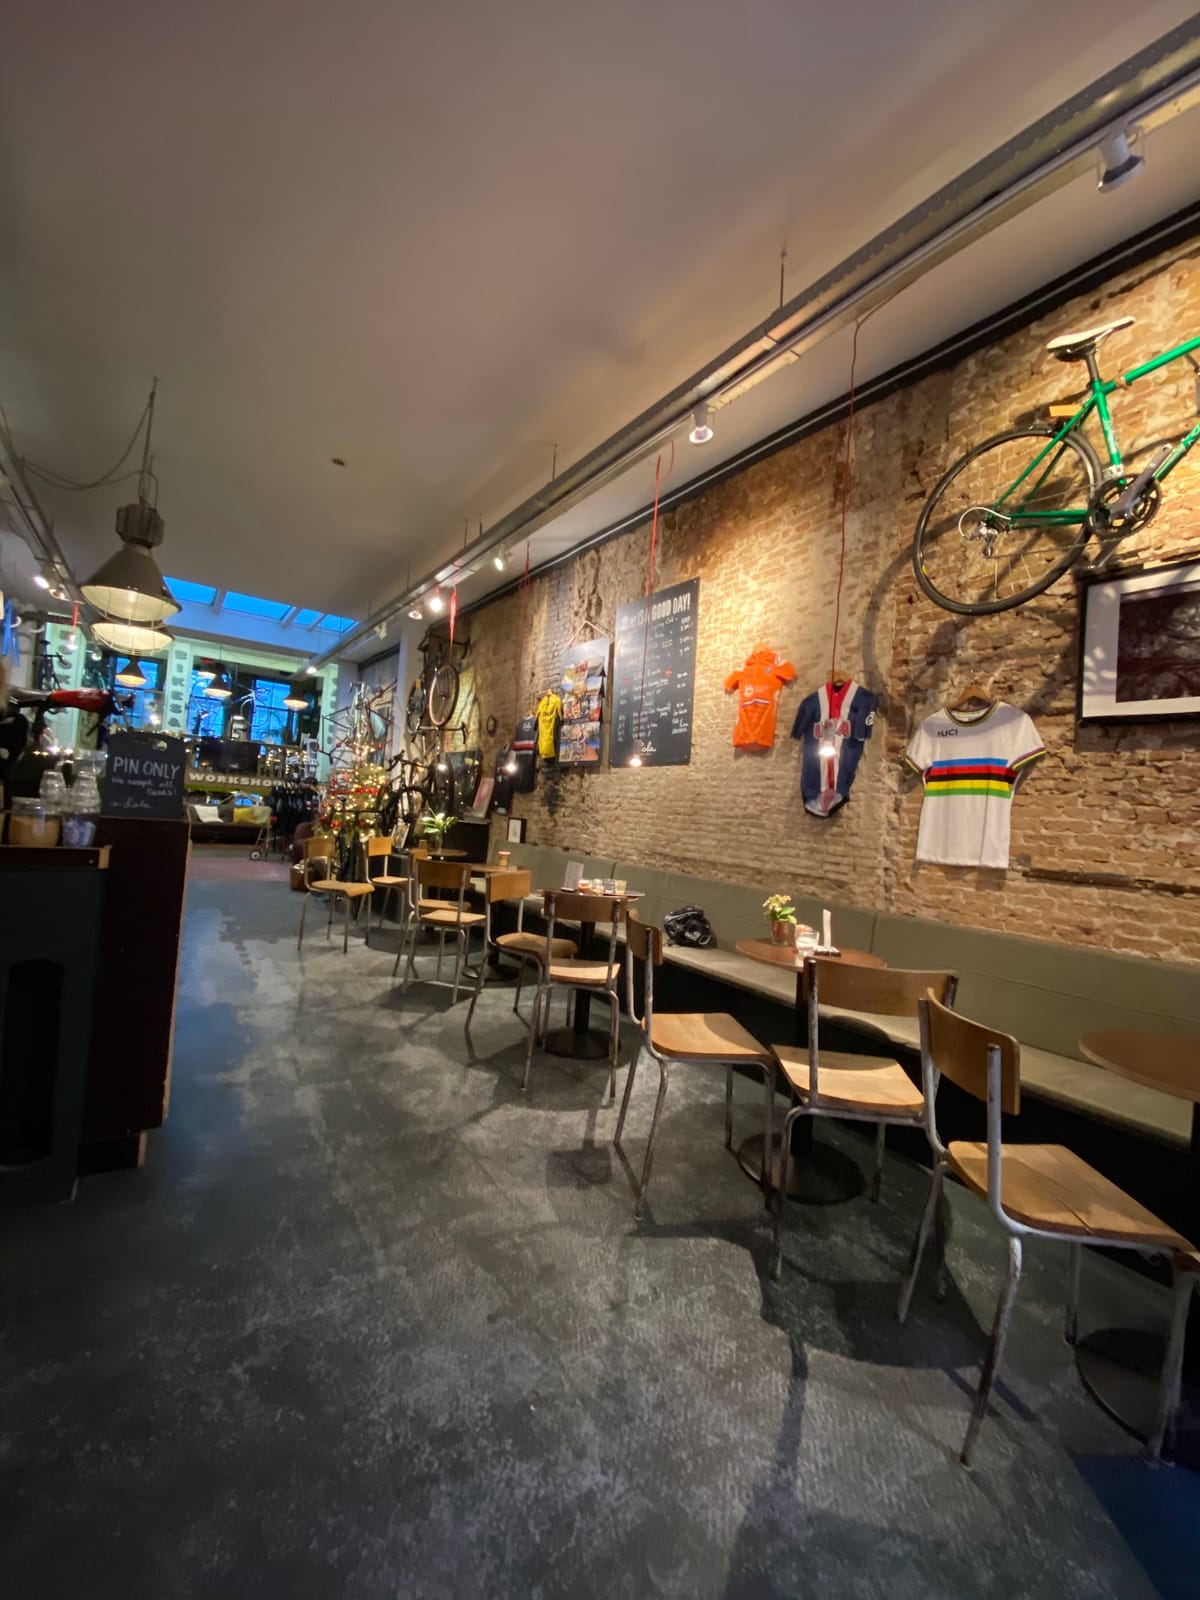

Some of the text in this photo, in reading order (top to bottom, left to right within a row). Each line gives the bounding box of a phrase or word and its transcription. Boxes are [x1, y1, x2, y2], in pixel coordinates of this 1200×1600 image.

[651, 599, 672, 621] GOOD
[672, 592, 691, 614] DAY!
[940, 728, 958, 737] UCI
[113, 756, 180, 780] PIN ONLY
